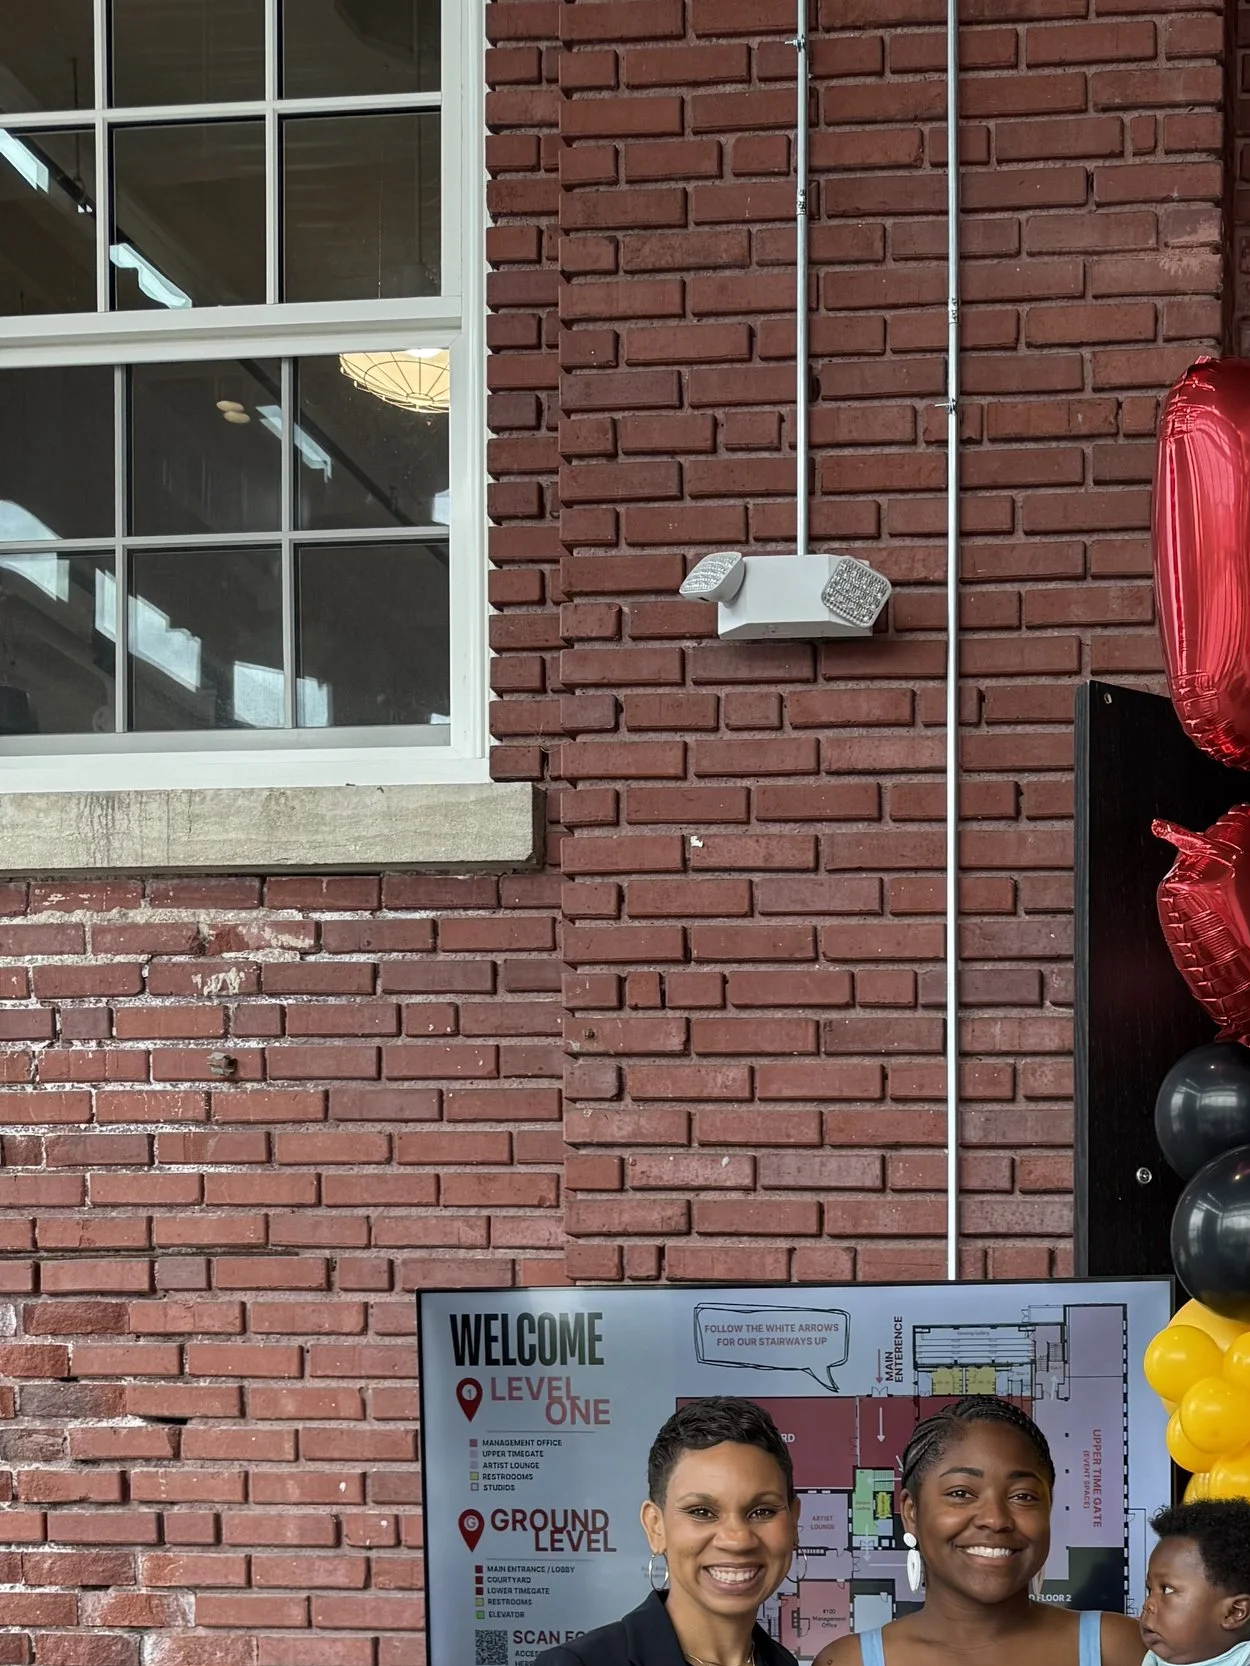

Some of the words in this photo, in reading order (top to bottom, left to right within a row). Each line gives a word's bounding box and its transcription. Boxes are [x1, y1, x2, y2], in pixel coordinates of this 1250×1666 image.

[704, 1324, 744, 1333] FOLLOW
[745, 1324, 764, 1332] THE
[765, 1324, 796, 1332] WHITE
[798, 1323, 839, 1332] ARROWS
[449, 1312, 604, 1366] WELCOME
[716, 1337, 735, 1346] FOR
[737, 1337, 757, 1346] OUR
[759, 1336, 813, 1345] STAIRWAYS
[814, 1336, 827, 1345] UP
[894, 1316, 903, 1383] ENTERENCE
[885, 1351, 894, 1382] MAIN
[491, 1377, 580, 1401] LEVEL
[545, 1399, 610, 1425] ONE
[482, 1439, 535, 1447] MANAGEMENT
[536, 1439, 563, 1447] OFFICE
[1092, 1429, 1102, 1465] UPPER
[482, 1450, 506, 1458] UPPER
[1092, 1468, 1102, 1495] TIME
[490, 1508, 609, 1531] GROUND
[1093, 1497, 1103, 1528] GATE
[466, 1517, 477, 1529] G
[534, 1530, 617, 1552] LEVEL
[487, 1565, 506, 1573] MAIN
[507, 1565, 546, 1573] ENTRANCE
[551, 1566, 576, 1574] LOBBY
[487, 1576, 531, 1584] COURTYARD
[514, 1587, 550, 1595] TIMEGATE
[1036, 1594, 1065, 1602] FLOOR
[1065, 1594, 1072, 1602] 2
[487, 1598, 532, 1606] RESTROOMS
[513, 1630, 560, 1644] SCAN
[565, 1631, 585, 1642] FO
